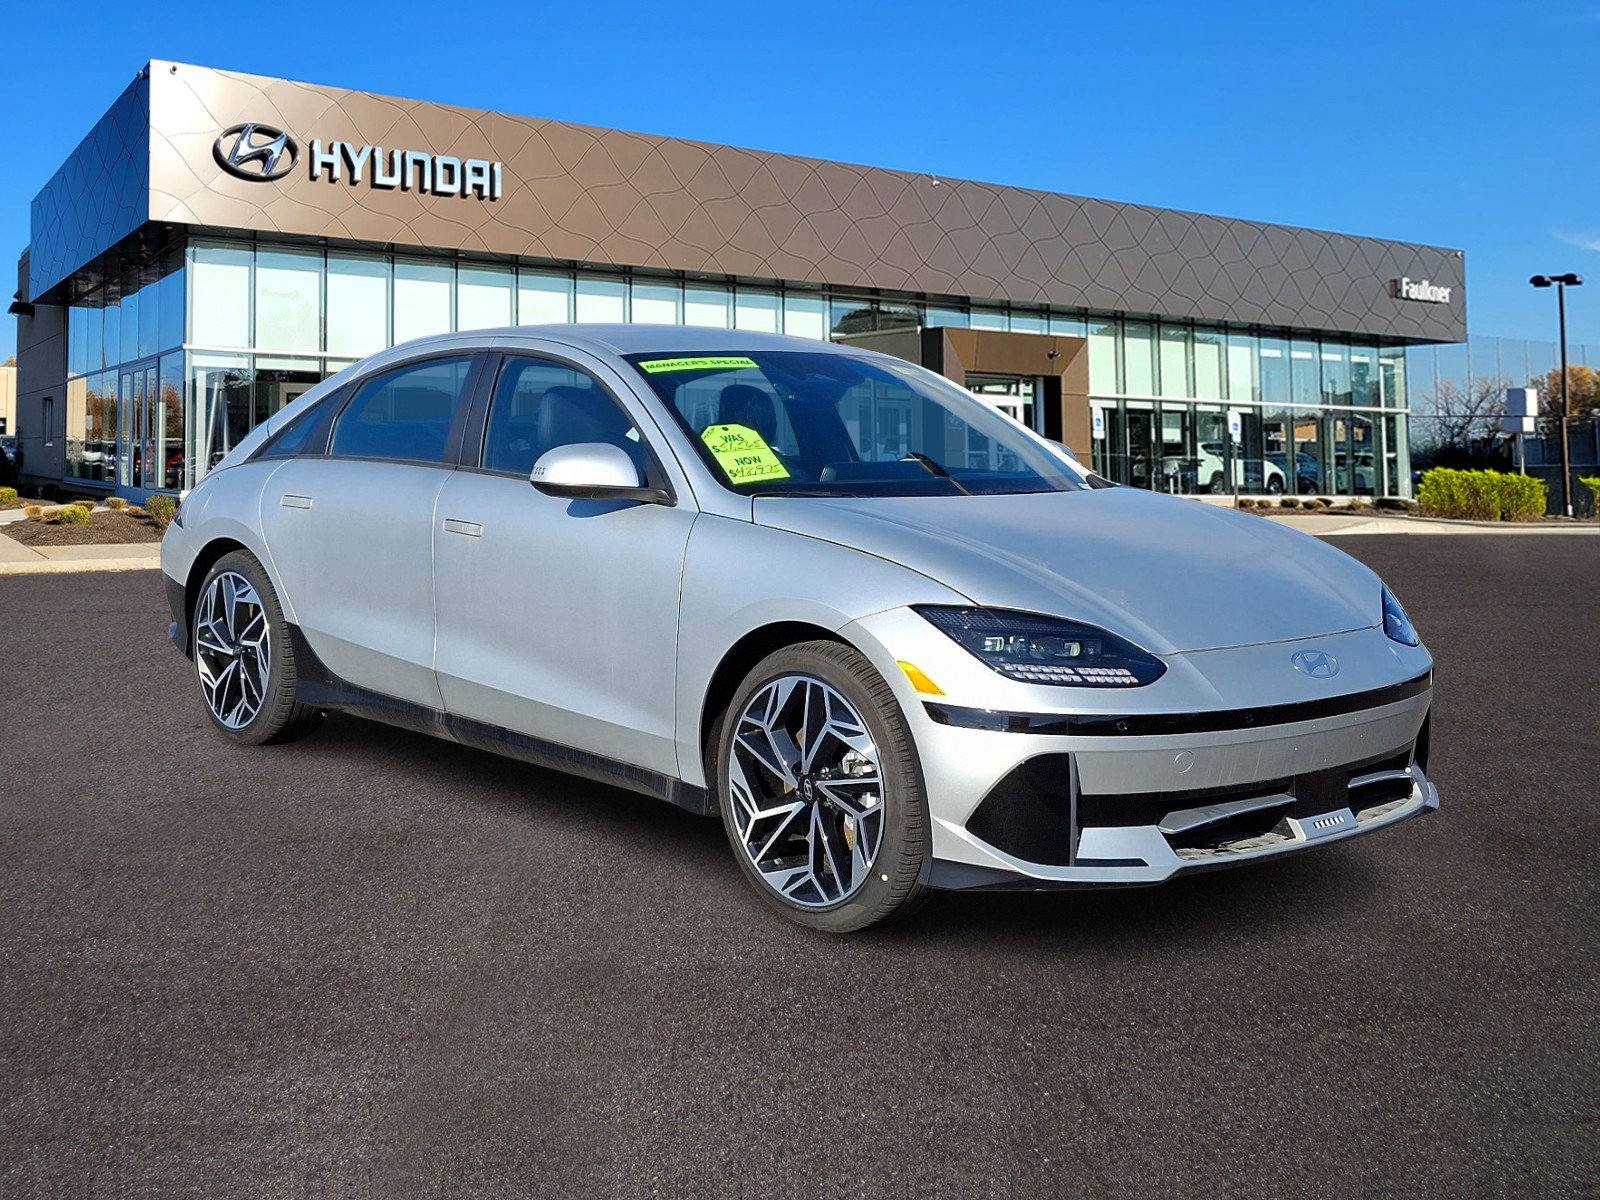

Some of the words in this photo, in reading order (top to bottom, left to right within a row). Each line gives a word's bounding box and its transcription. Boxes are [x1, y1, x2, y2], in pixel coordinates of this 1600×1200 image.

[310, 138, 502, 201] HYUNDAI
[1401, 277, 1452, 303] Faulkner
[645, 360, 708, 370] MANAGER'S
[720, 434, 745, 443] WAS
[734, 455, 762, 466] NOW
